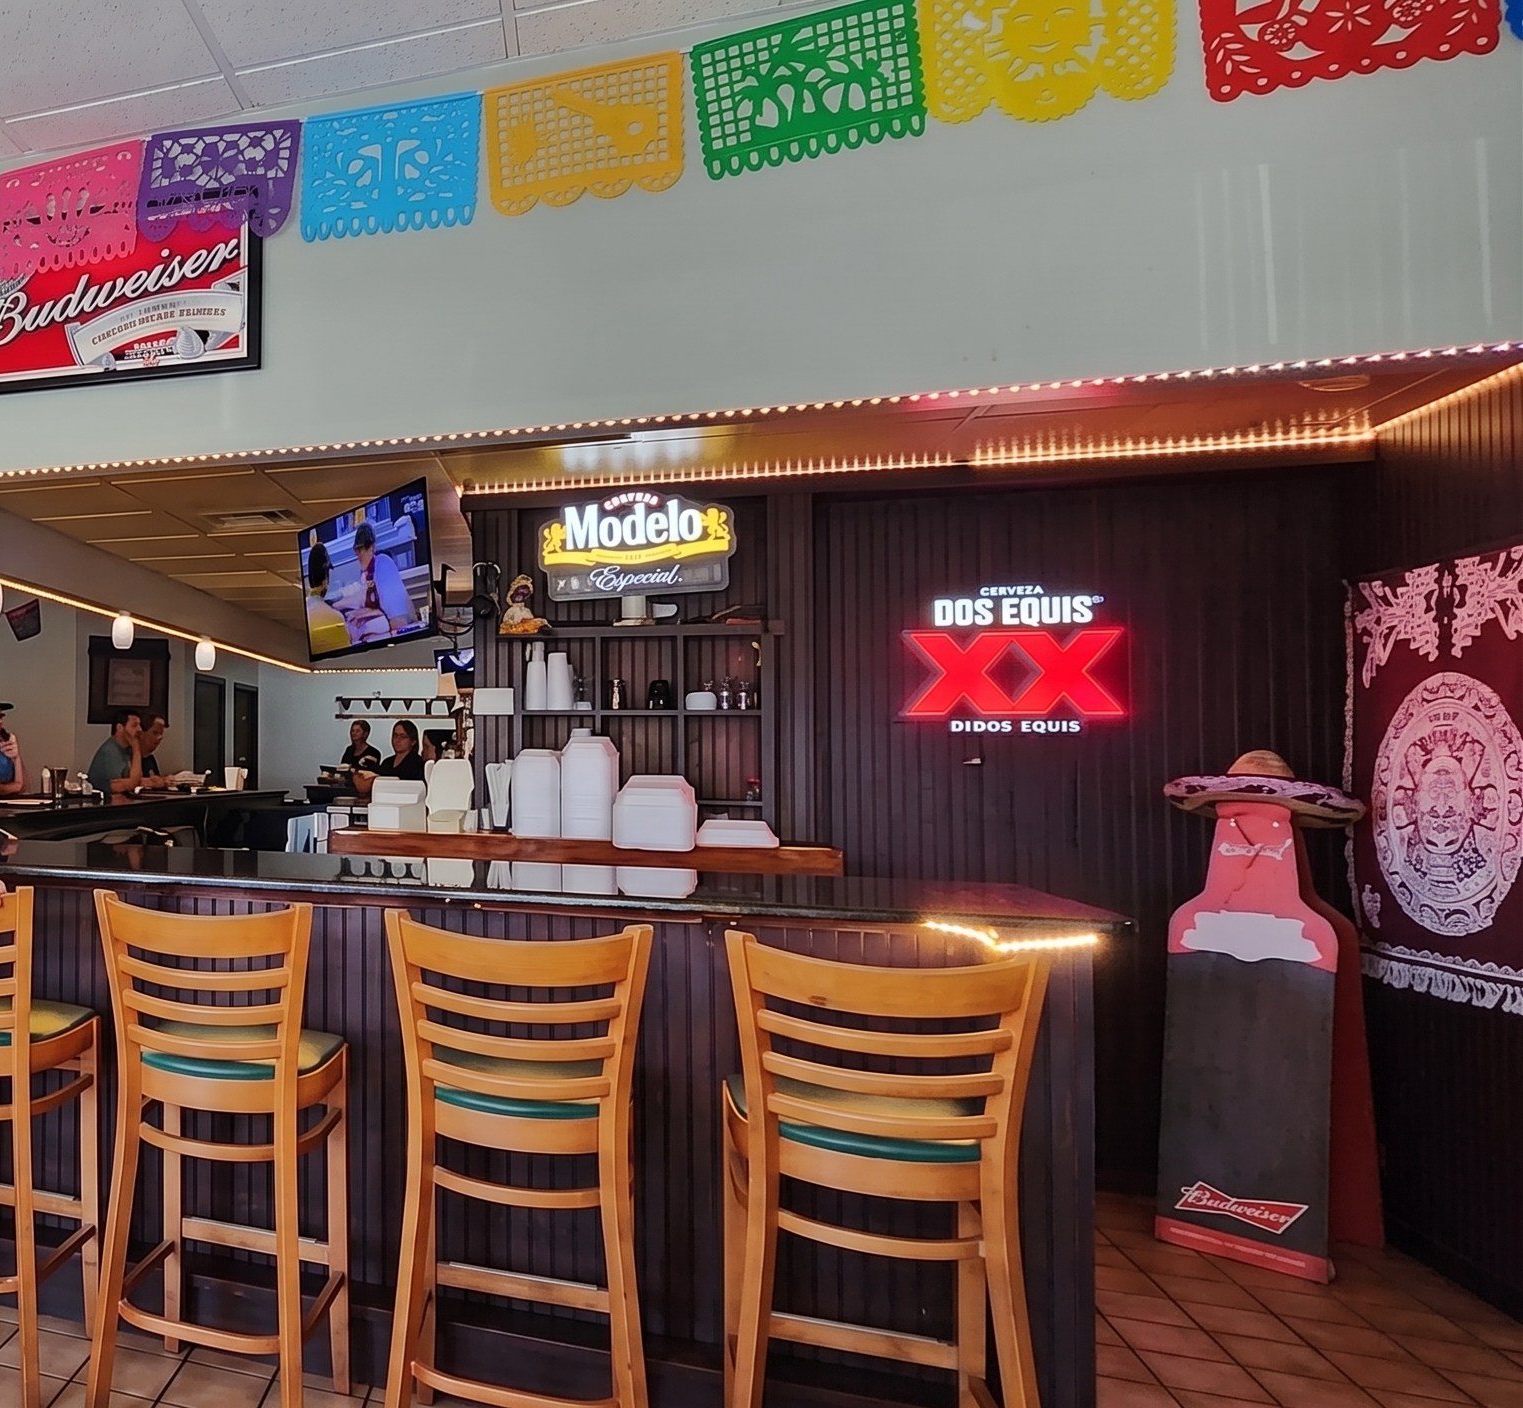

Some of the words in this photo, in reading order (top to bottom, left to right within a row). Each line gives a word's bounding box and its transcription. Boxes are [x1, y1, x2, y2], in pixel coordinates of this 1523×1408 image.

[564, 498, 703, 550] Modelo
[979, 585, 1044, 596] CERVEZA
[933, 598, 994, 627] DOS
[901, 628, 1126, 716] XX
[950, 720, 1013, 733] DIDOS
[1020, 720, 1082, 734] EQUIS
[1181, 1186, 1293, 1224] Budweiser
